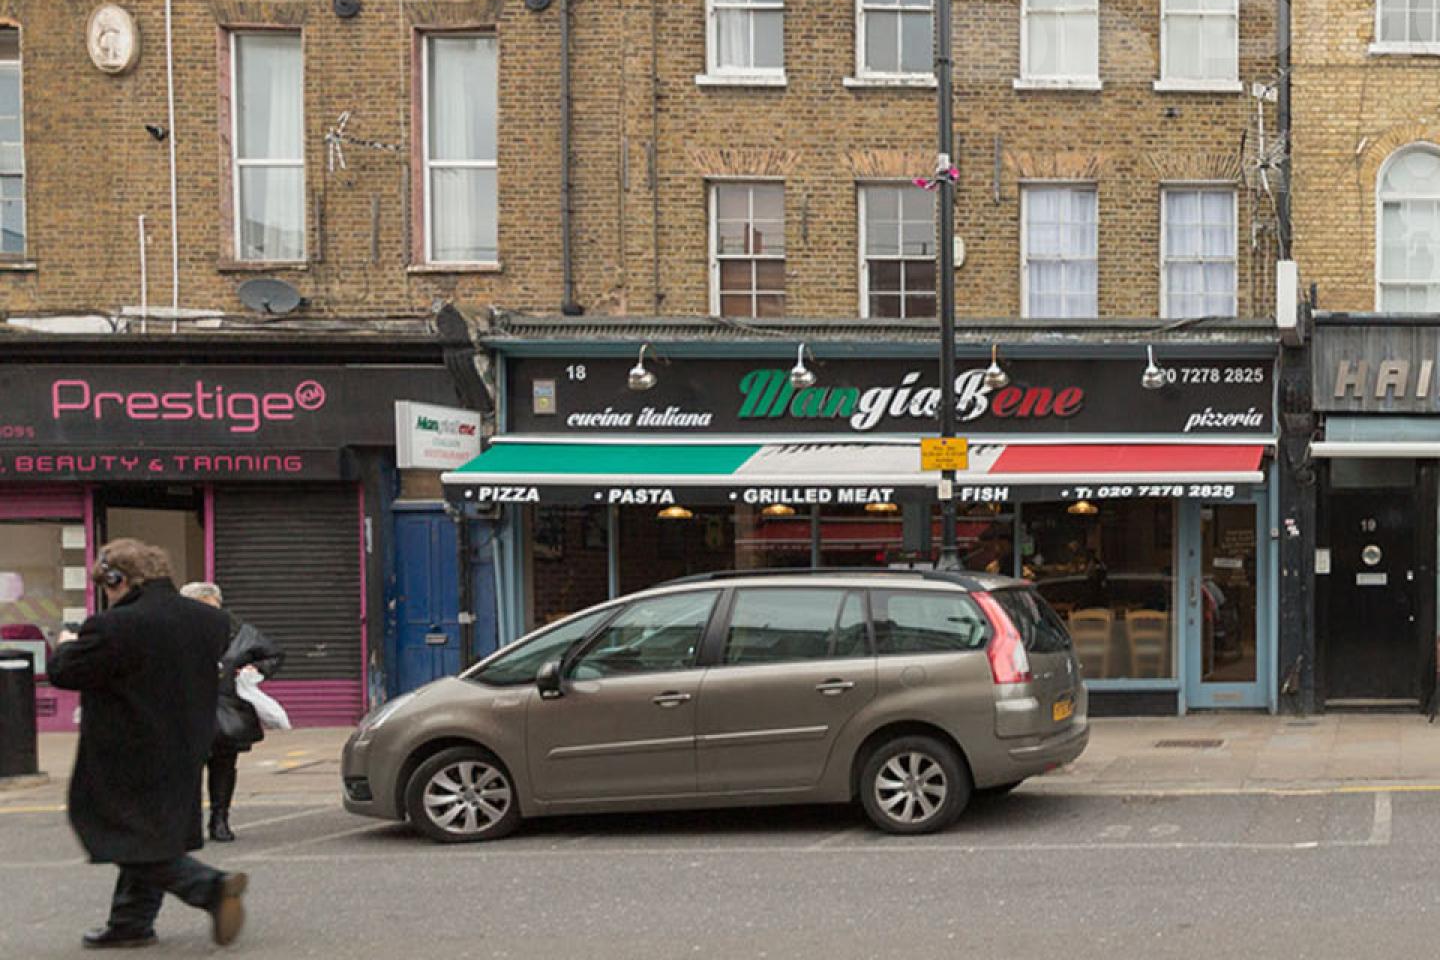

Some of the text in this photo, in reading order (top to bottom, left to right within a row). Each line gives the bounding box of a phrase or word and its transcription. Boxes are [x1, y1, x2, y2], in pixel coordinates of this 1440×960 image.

[564, 364, 588, 381] 18
[1181, 367, 1221, 383] 7278
[1223, 367, 1264, 383] 2825
[52, 378, 295, 433] Prestige
[566, 405, 713, 428] cucina italiana
[1182, 406, 1264, 433] pizzeria
[15, 455, 140, 472] BEAUTY
[149, 458, 164, 472] &
[174, 455, 304, 472] TANNING
[478, 487, 541, 502] PIZZA
[607, 488, 676, 504] PASTA
[743, 487, 895, 504] GRILLED MEAT
[961, 486, 1009, 502] FISH
[1097, 485, 1132, 499] 020
[1137, 484, 1184, 498] 7278
[1187, 483, 1235, 499] 2825
